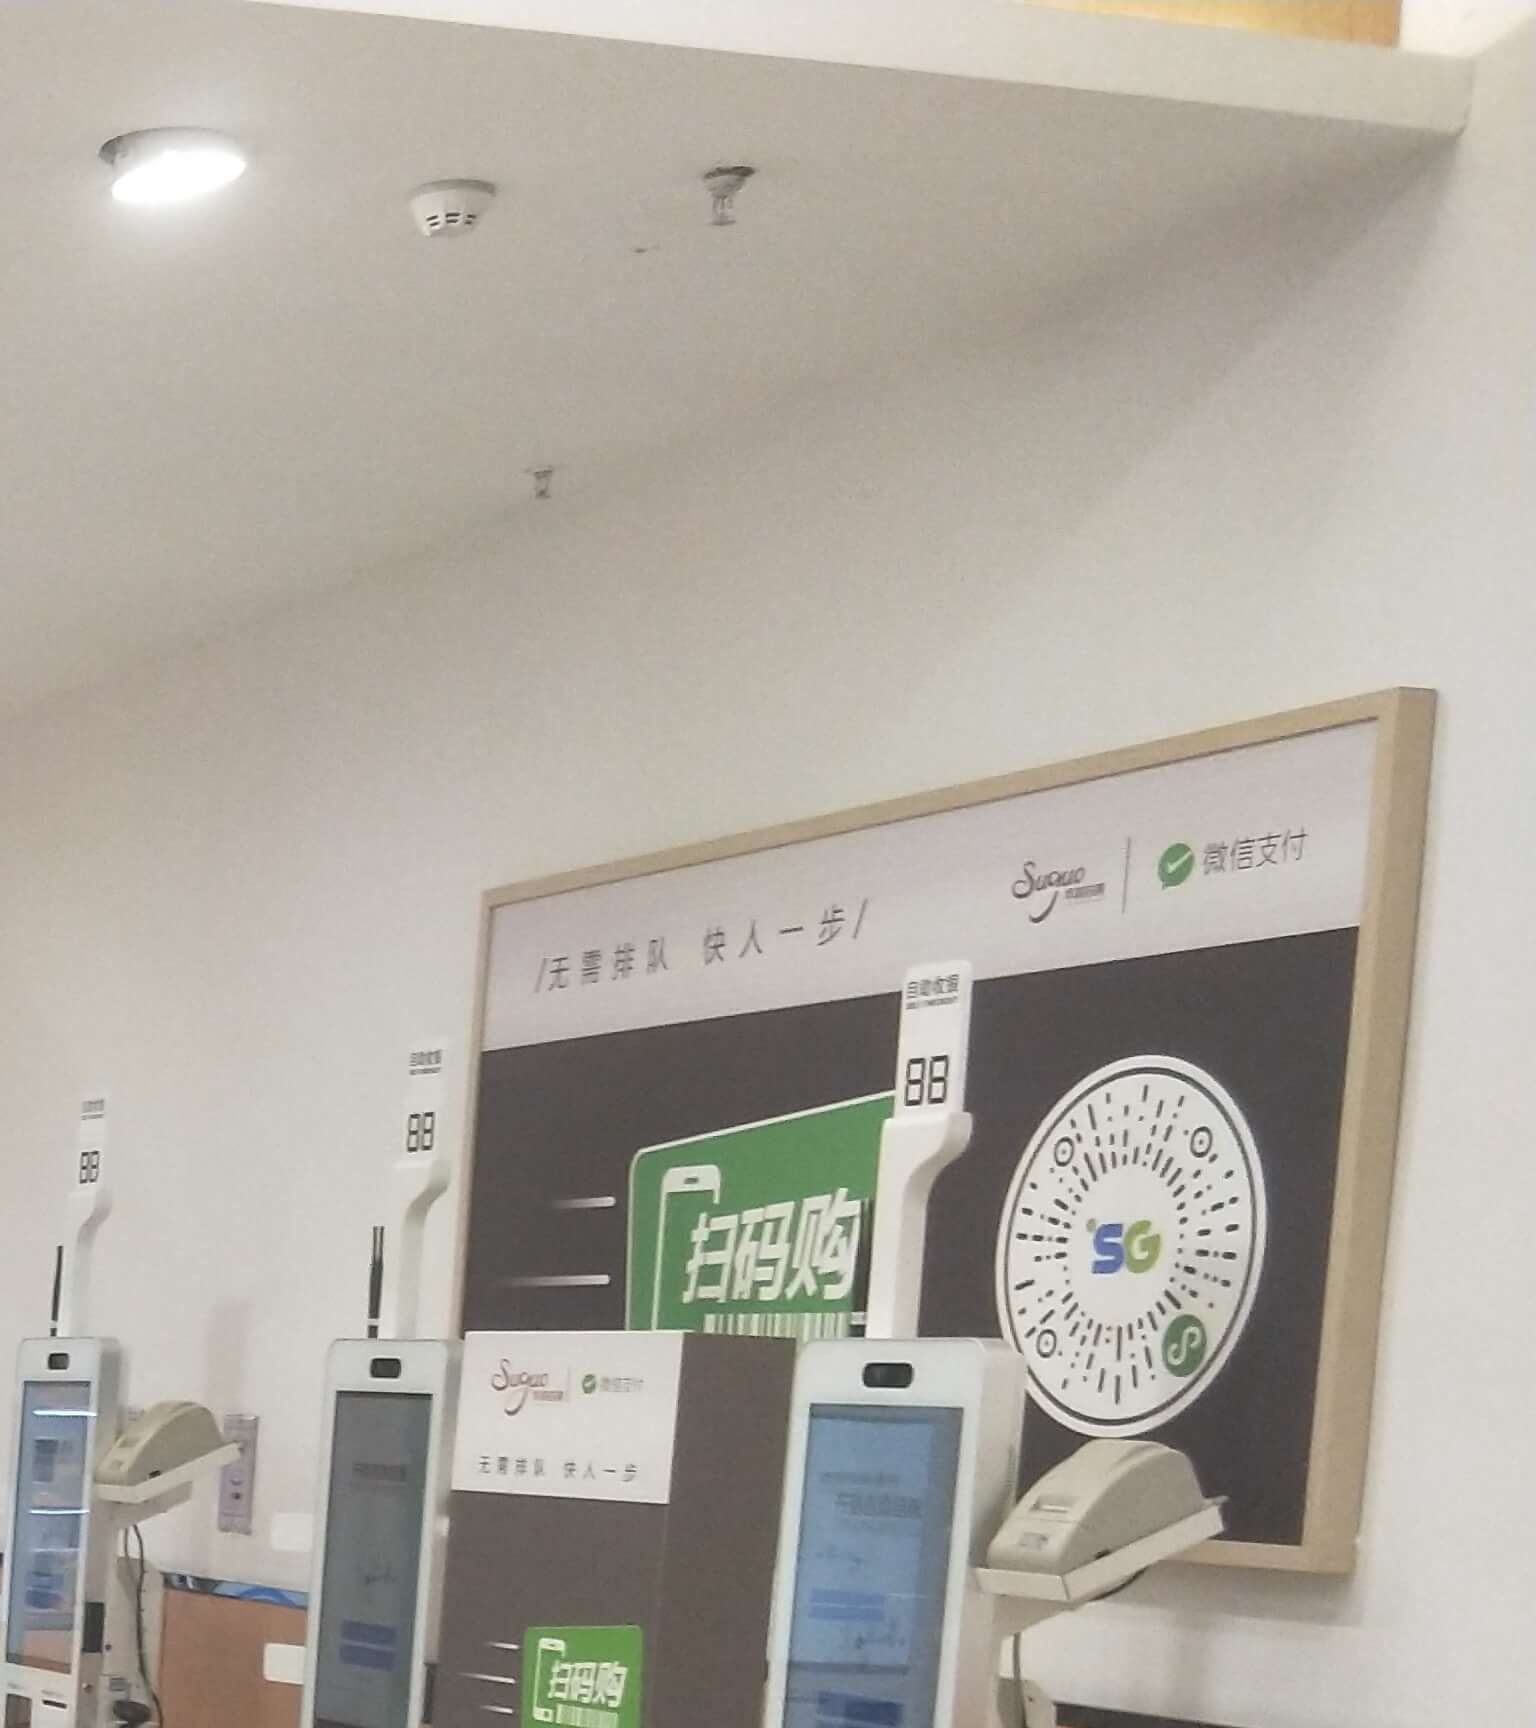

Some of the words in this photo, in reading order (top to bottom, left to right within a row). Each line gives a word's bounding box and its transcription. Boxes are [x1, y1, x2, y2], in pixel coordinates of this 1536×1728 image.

[1202, 827, 1308, 876] 微信支付
[1011, 860, 1086, 924] Suguo
[904, 1055, 950, 1107] 88
[683, 1187, 862, 1304] 扫码购
[1091, 1219, 1161, 1274] SG
